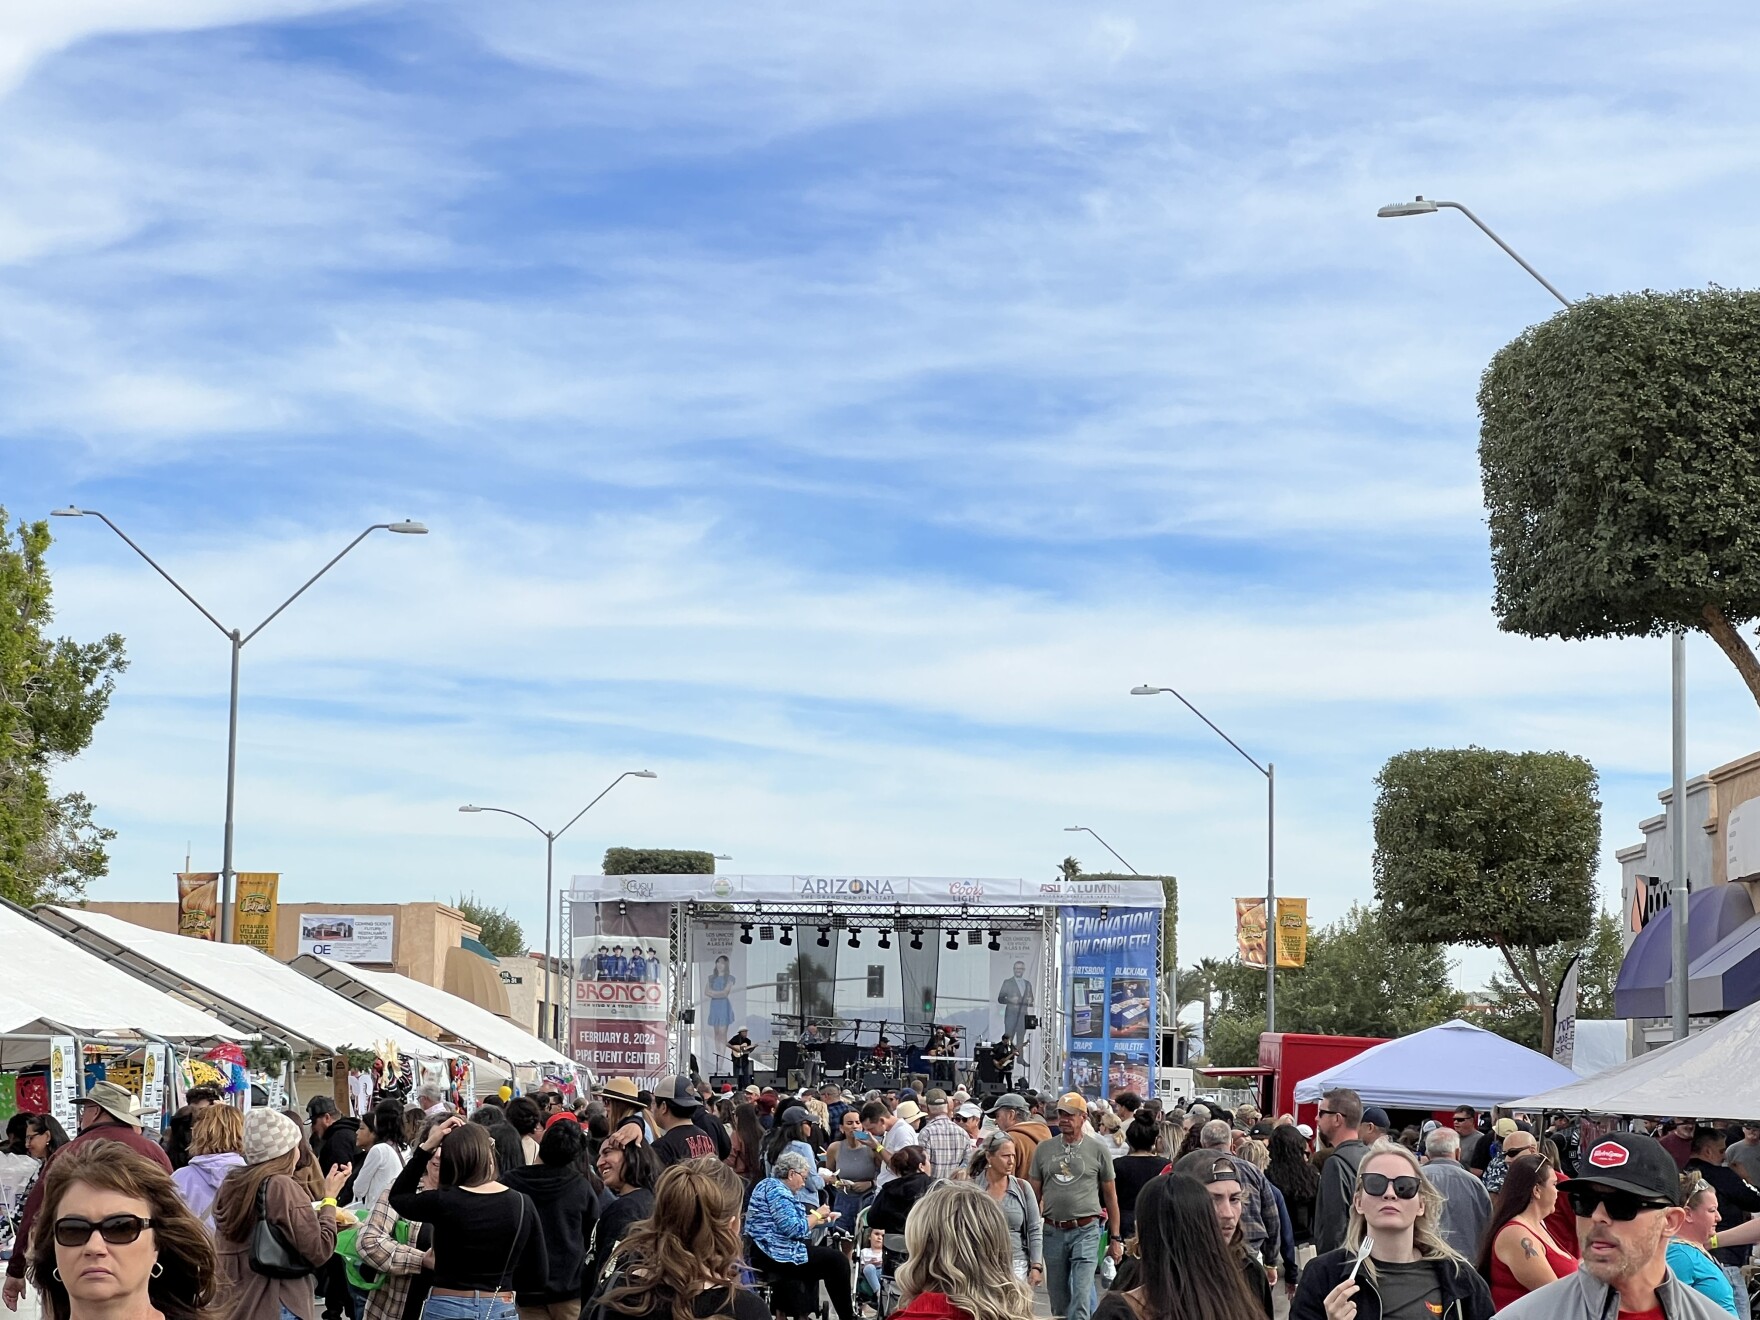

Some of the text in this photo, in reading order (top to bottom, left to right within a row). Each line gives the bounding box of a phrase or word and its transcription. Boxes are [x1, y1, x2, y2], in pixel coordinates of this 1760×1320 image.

[801, 878, 894, 895] ARIZONA
[950, 881, 984, 896] Coors
[1040, 883, 1120, 894] ASU ALUMNI
[952, 895, 980, 903] LIGHT
[1066, 911, 1153, 937] RENOVATION
[313, 944, 331, 955] OE
[1066, 934, 1150, 957] NOW COMPLETE!
[1115, 966, 1148, 977] BLACKJACK
[576, 982, 661, 1003] BRONCO
[580, 1031, 656, 1045] FEBRUARY 8, 2024
[1073, 1041, 1093, 1050] CRAPS
[1114, 1042, 1144, 1051] ROULETTE
[575, 1049, 660, 1065] PIPA EVENT CENTER
